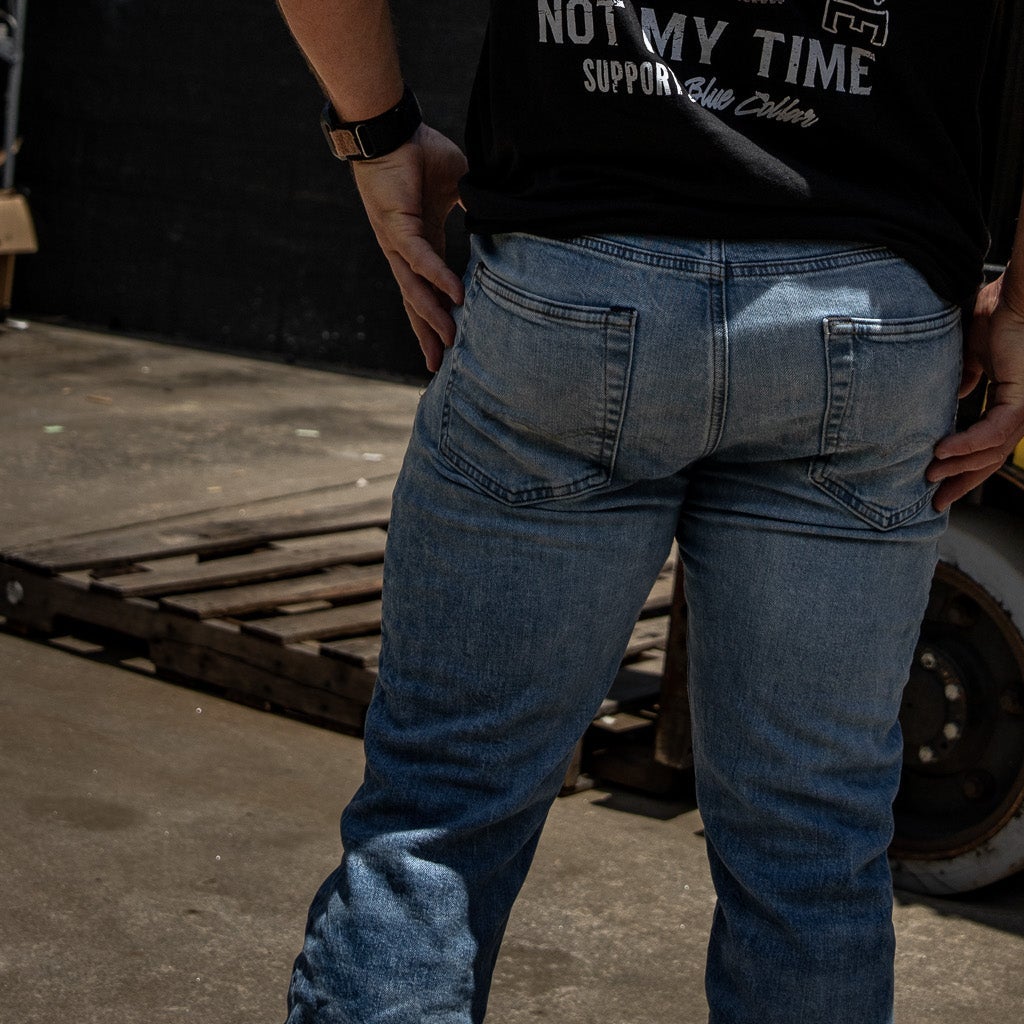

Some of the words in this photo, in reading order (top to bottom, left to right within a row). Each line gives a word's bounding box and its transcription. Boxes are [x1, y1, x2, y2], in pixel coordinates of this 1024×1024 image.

[640, 7, 730, 66] MY
[752, 28, 876, 97] TIME
[684, 76, 737, 112] Blue
[734, 90, 821, 128] Collar
